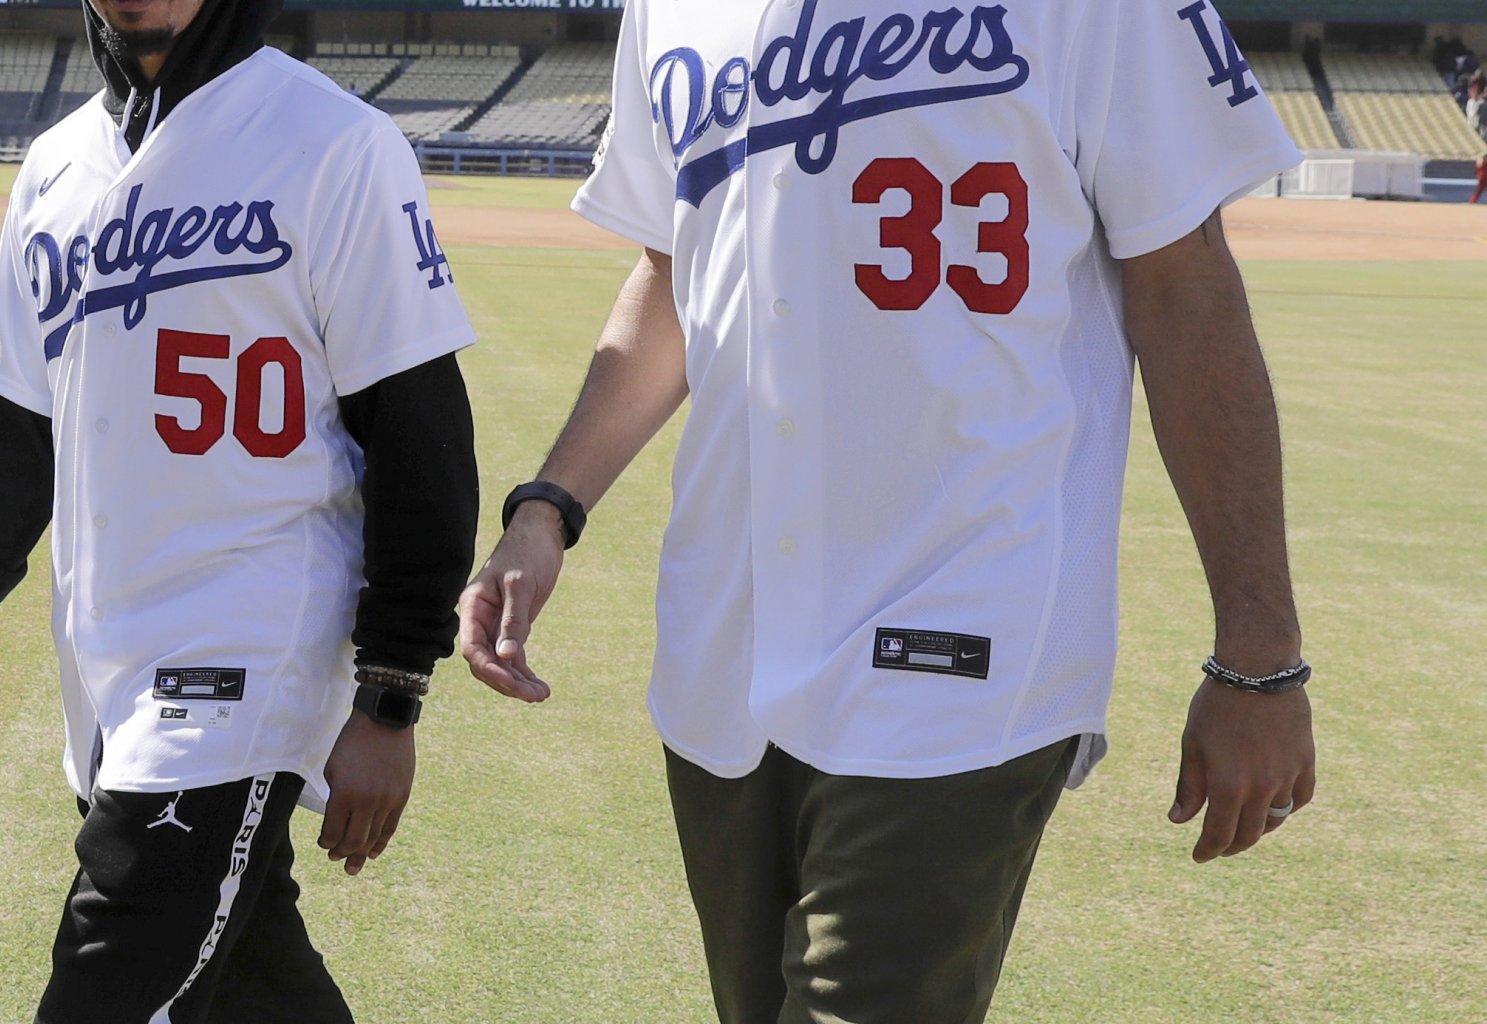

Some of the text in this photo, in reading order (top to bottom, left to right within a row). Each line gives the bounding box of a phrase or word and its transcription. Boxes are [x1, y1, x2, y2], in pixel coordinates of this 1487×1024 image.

[1177, 0, 1259, 108] LA
[24, 183, 293, 332] Dodgers
[852, 157, 1030, 315] 33
[154, 328, 307, 459] 50
